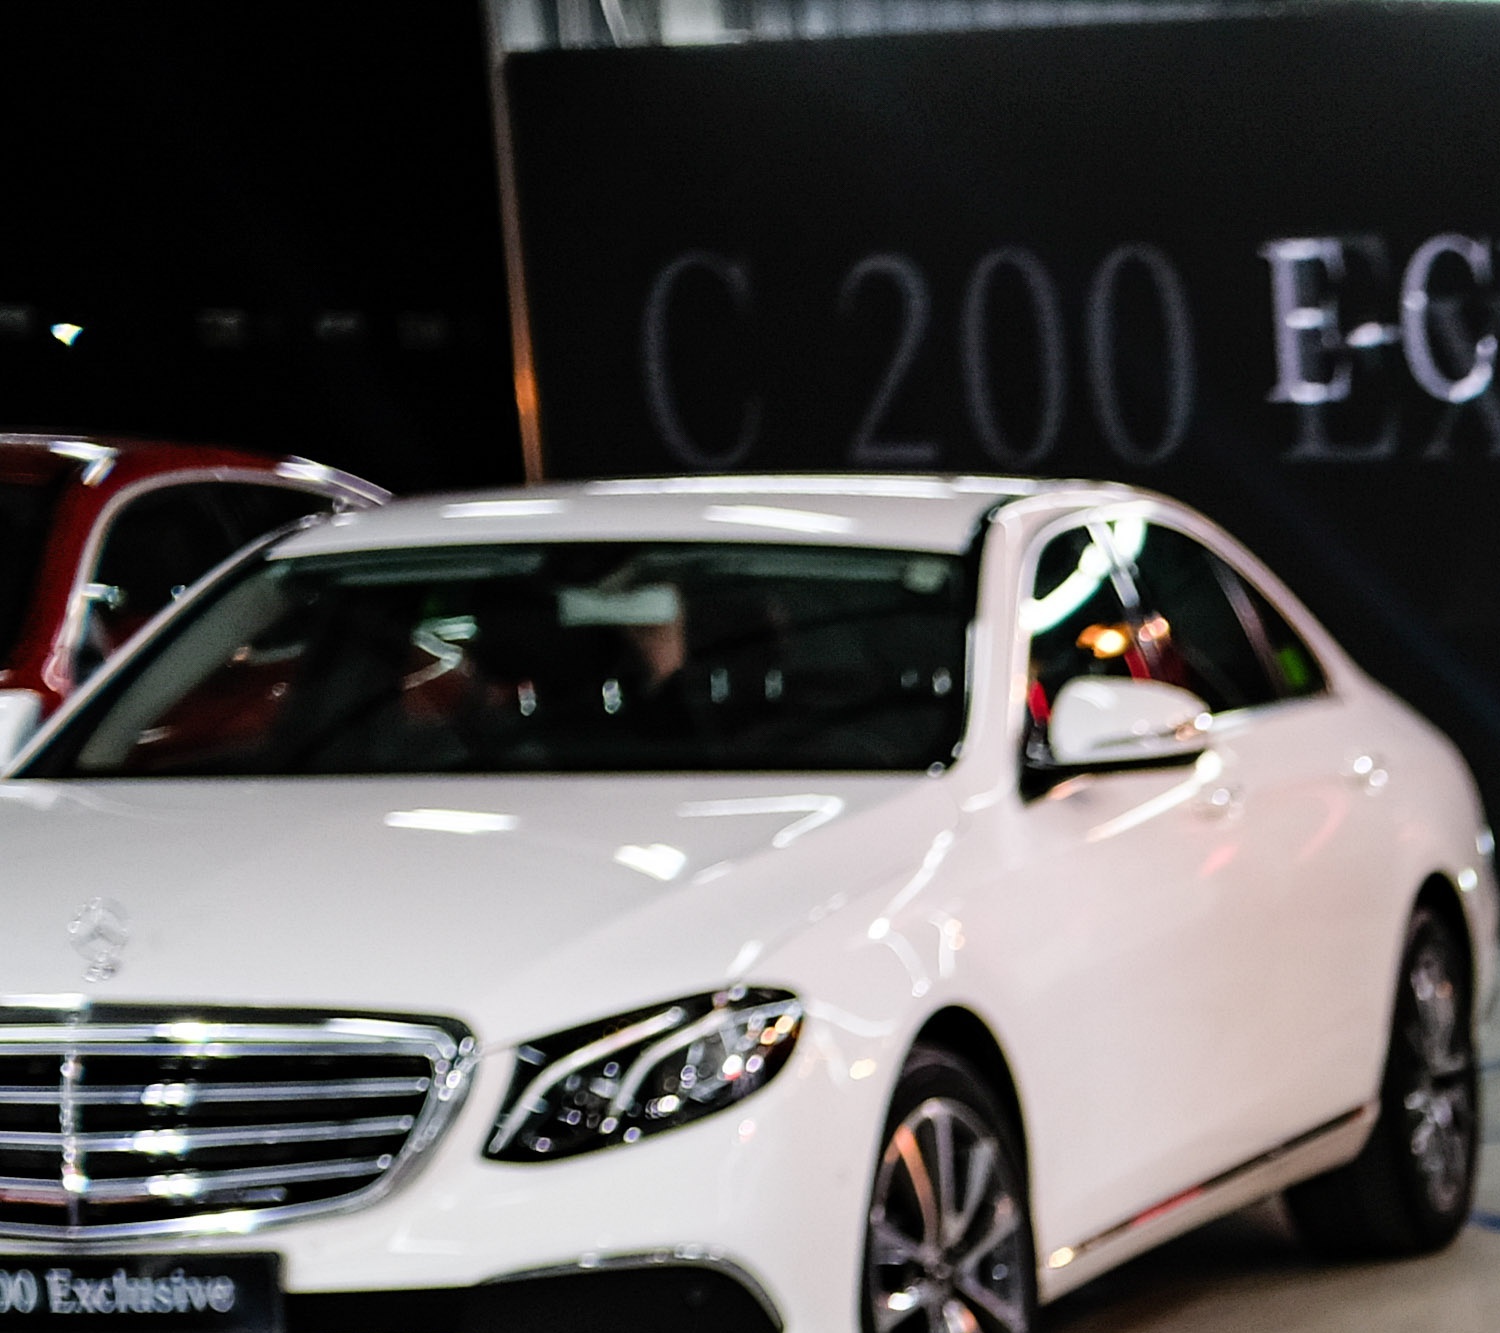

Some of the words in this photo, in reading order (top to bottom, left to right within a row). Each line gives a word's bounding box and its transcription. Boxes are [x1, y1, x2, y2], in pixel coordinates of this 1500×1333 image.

[641, 248, 756, 465] C
[838, 246, 1198, 464] 200
[46, 1267, 236, 1313] Exclusive
